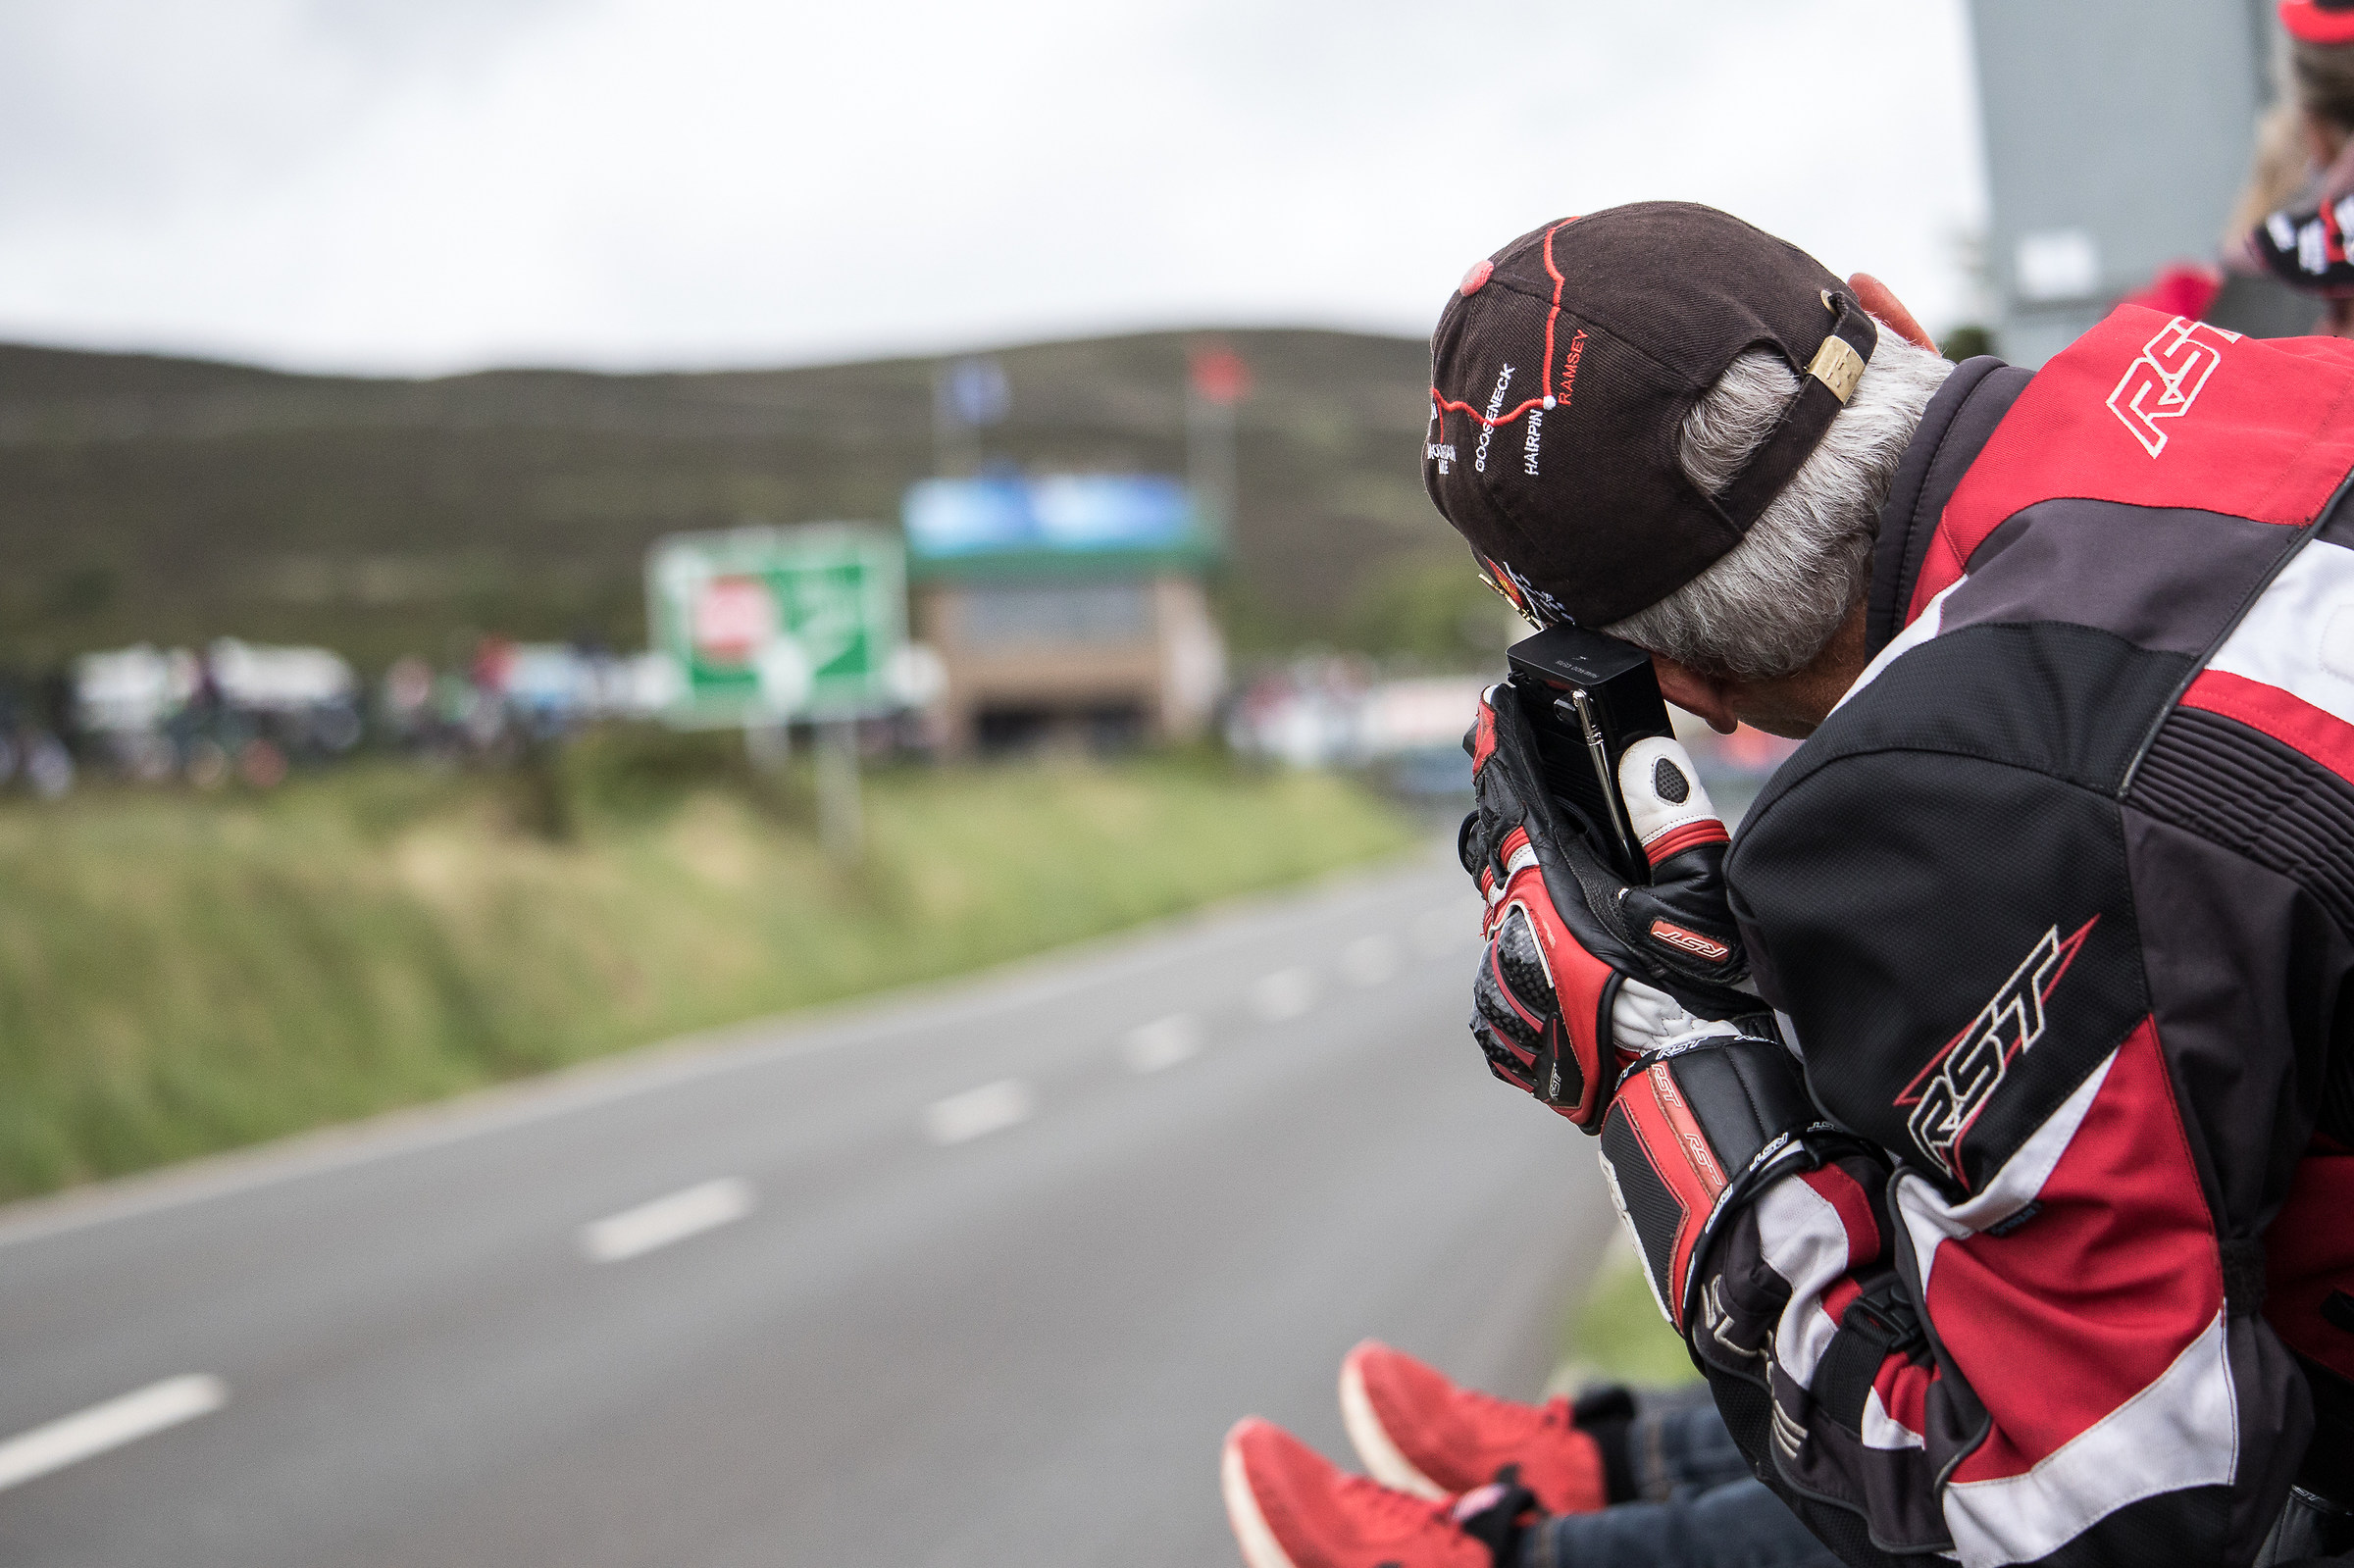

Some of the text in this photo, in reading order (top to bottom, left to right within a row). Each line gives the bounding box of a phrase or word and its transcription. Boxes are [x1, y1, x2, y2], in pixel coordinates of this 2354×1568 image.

[1557, 329, 1589, 406] RAMSEY
[1474, 362, 1516, 473] GOOSENECK
[1523, 408, 1544, 476] HAIRPIN
[1652, 931, 1728, 958] RST
[1655, 1036, 1710, 1061] RST
[1907, 923, 2059, 1180] RST
[1652, 1064, 1683, 1109] RST
[1683, 1133, 1723, 1187] RST
[1749, 1132, 1789, 1172] RST
